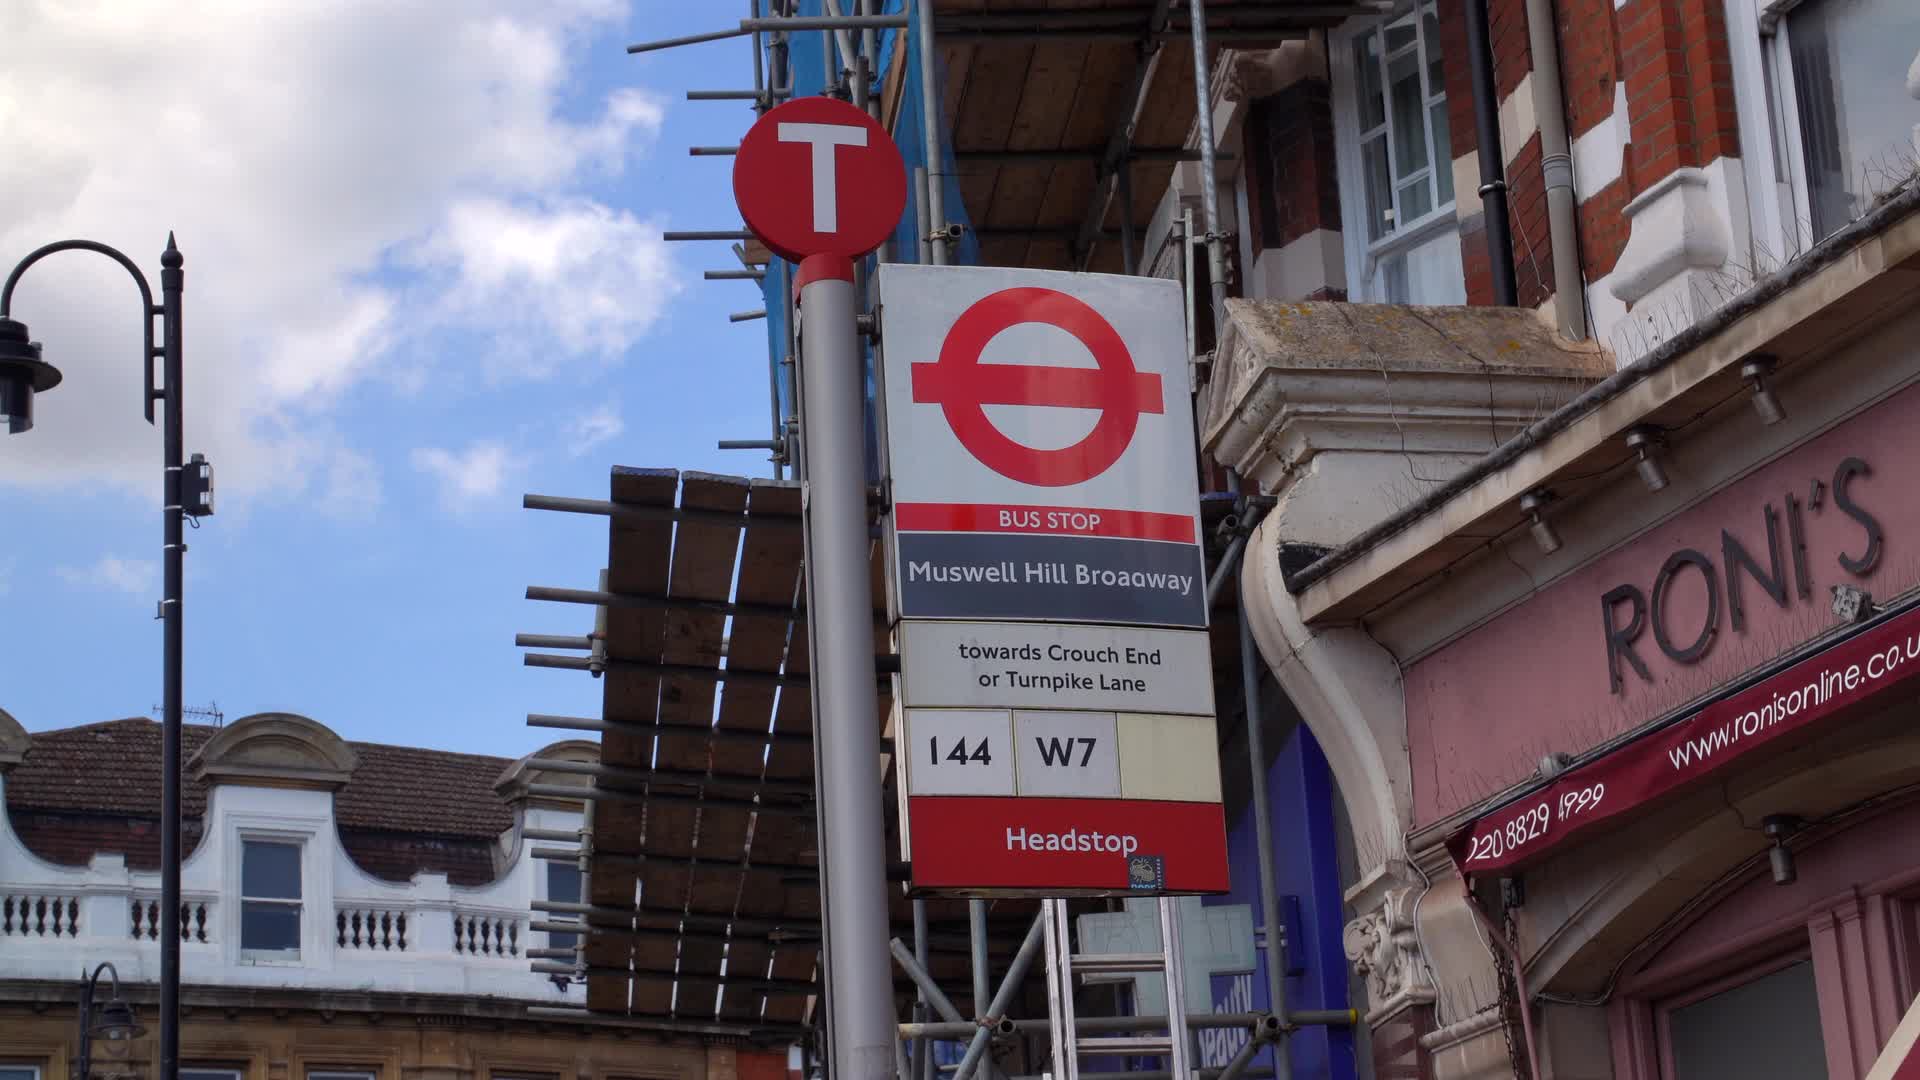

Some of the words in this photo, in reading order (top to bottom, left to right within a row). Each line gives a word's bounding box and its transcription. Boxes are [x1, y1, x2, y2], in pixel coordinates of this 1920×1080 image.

[778, 122, 868, 233] T
[999, 510, 1041, 528] BUS
[1047, 511, 1101, 531] STOP
[909, 561, 1017, 583] Muswell
[1025, 562, 1068, 584] Hill
[1601, 457, 1883, 695] RONI'S
[959, 643, 1042, 661] towards
[1048, 644, 1119, 663] Crouch
[1125, 648, 1161, 665] End
[979, 674, 1000, 687] or
[1006, 671, 1093, 692] Turnpike
[1100, 674, 1146, 692] Lane
[930, 735, 992, 767] 144
[1036, 737, 1097, 768] W7
[1506, 803, 1550, 850] 8829
[1558, 783, 1605, 822] 4999
[1006, 827, 1138, 858] Headstop
